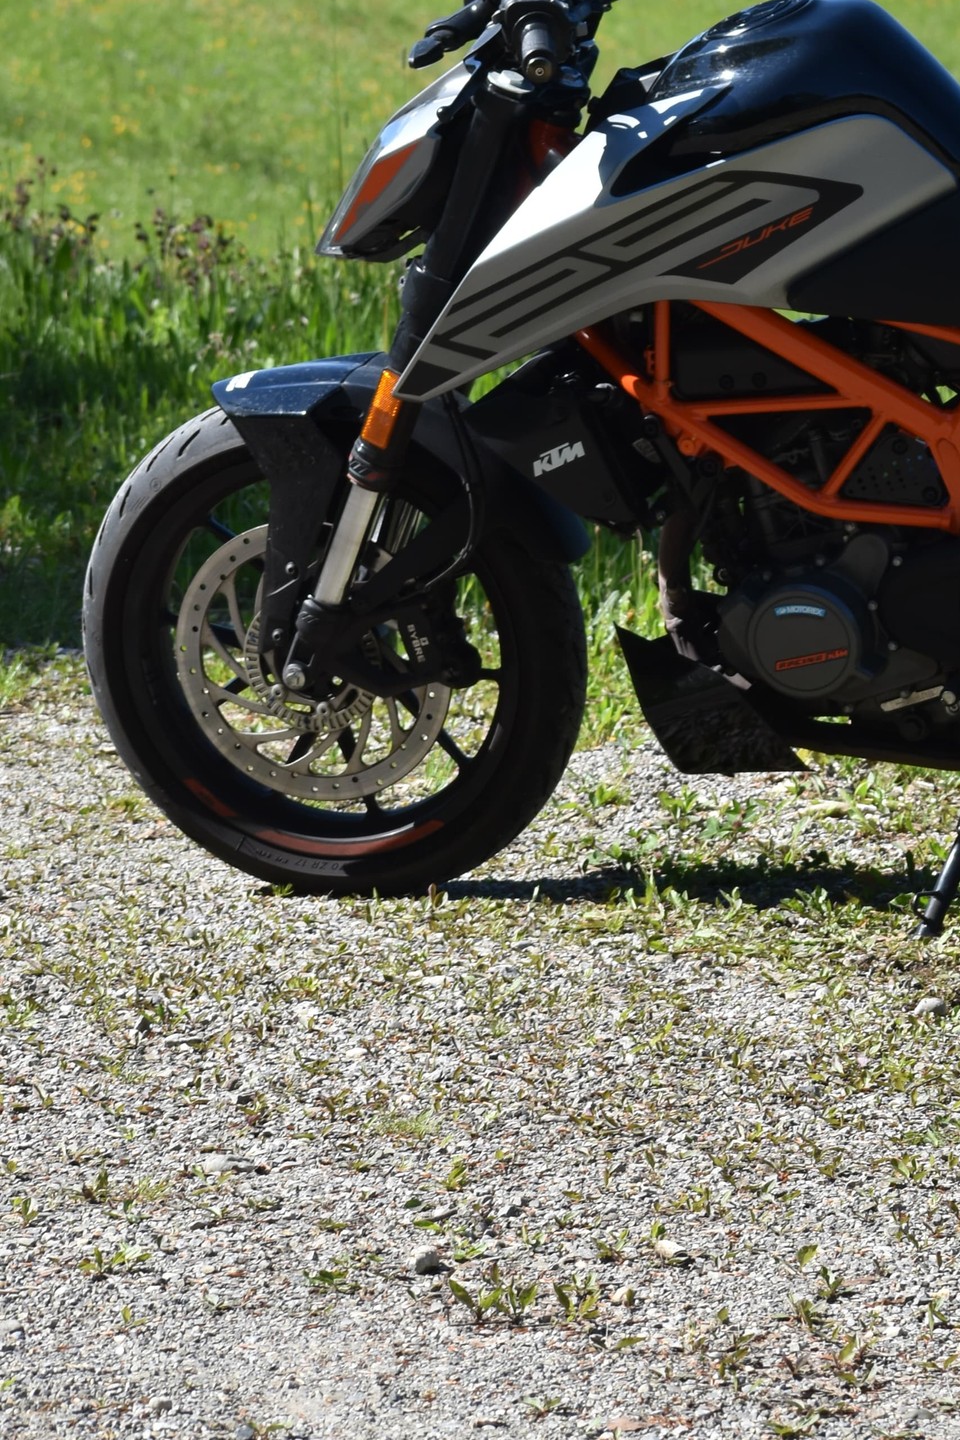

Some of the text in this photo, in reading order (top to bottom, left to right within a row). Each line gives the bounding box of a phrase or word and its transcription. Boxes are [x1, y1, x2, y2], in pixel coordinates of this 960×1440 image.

[697, 207, 813, 269] DUKE
[533, 441, 585, 477] KTM
[407, 624, 425, 663] BYBRE
